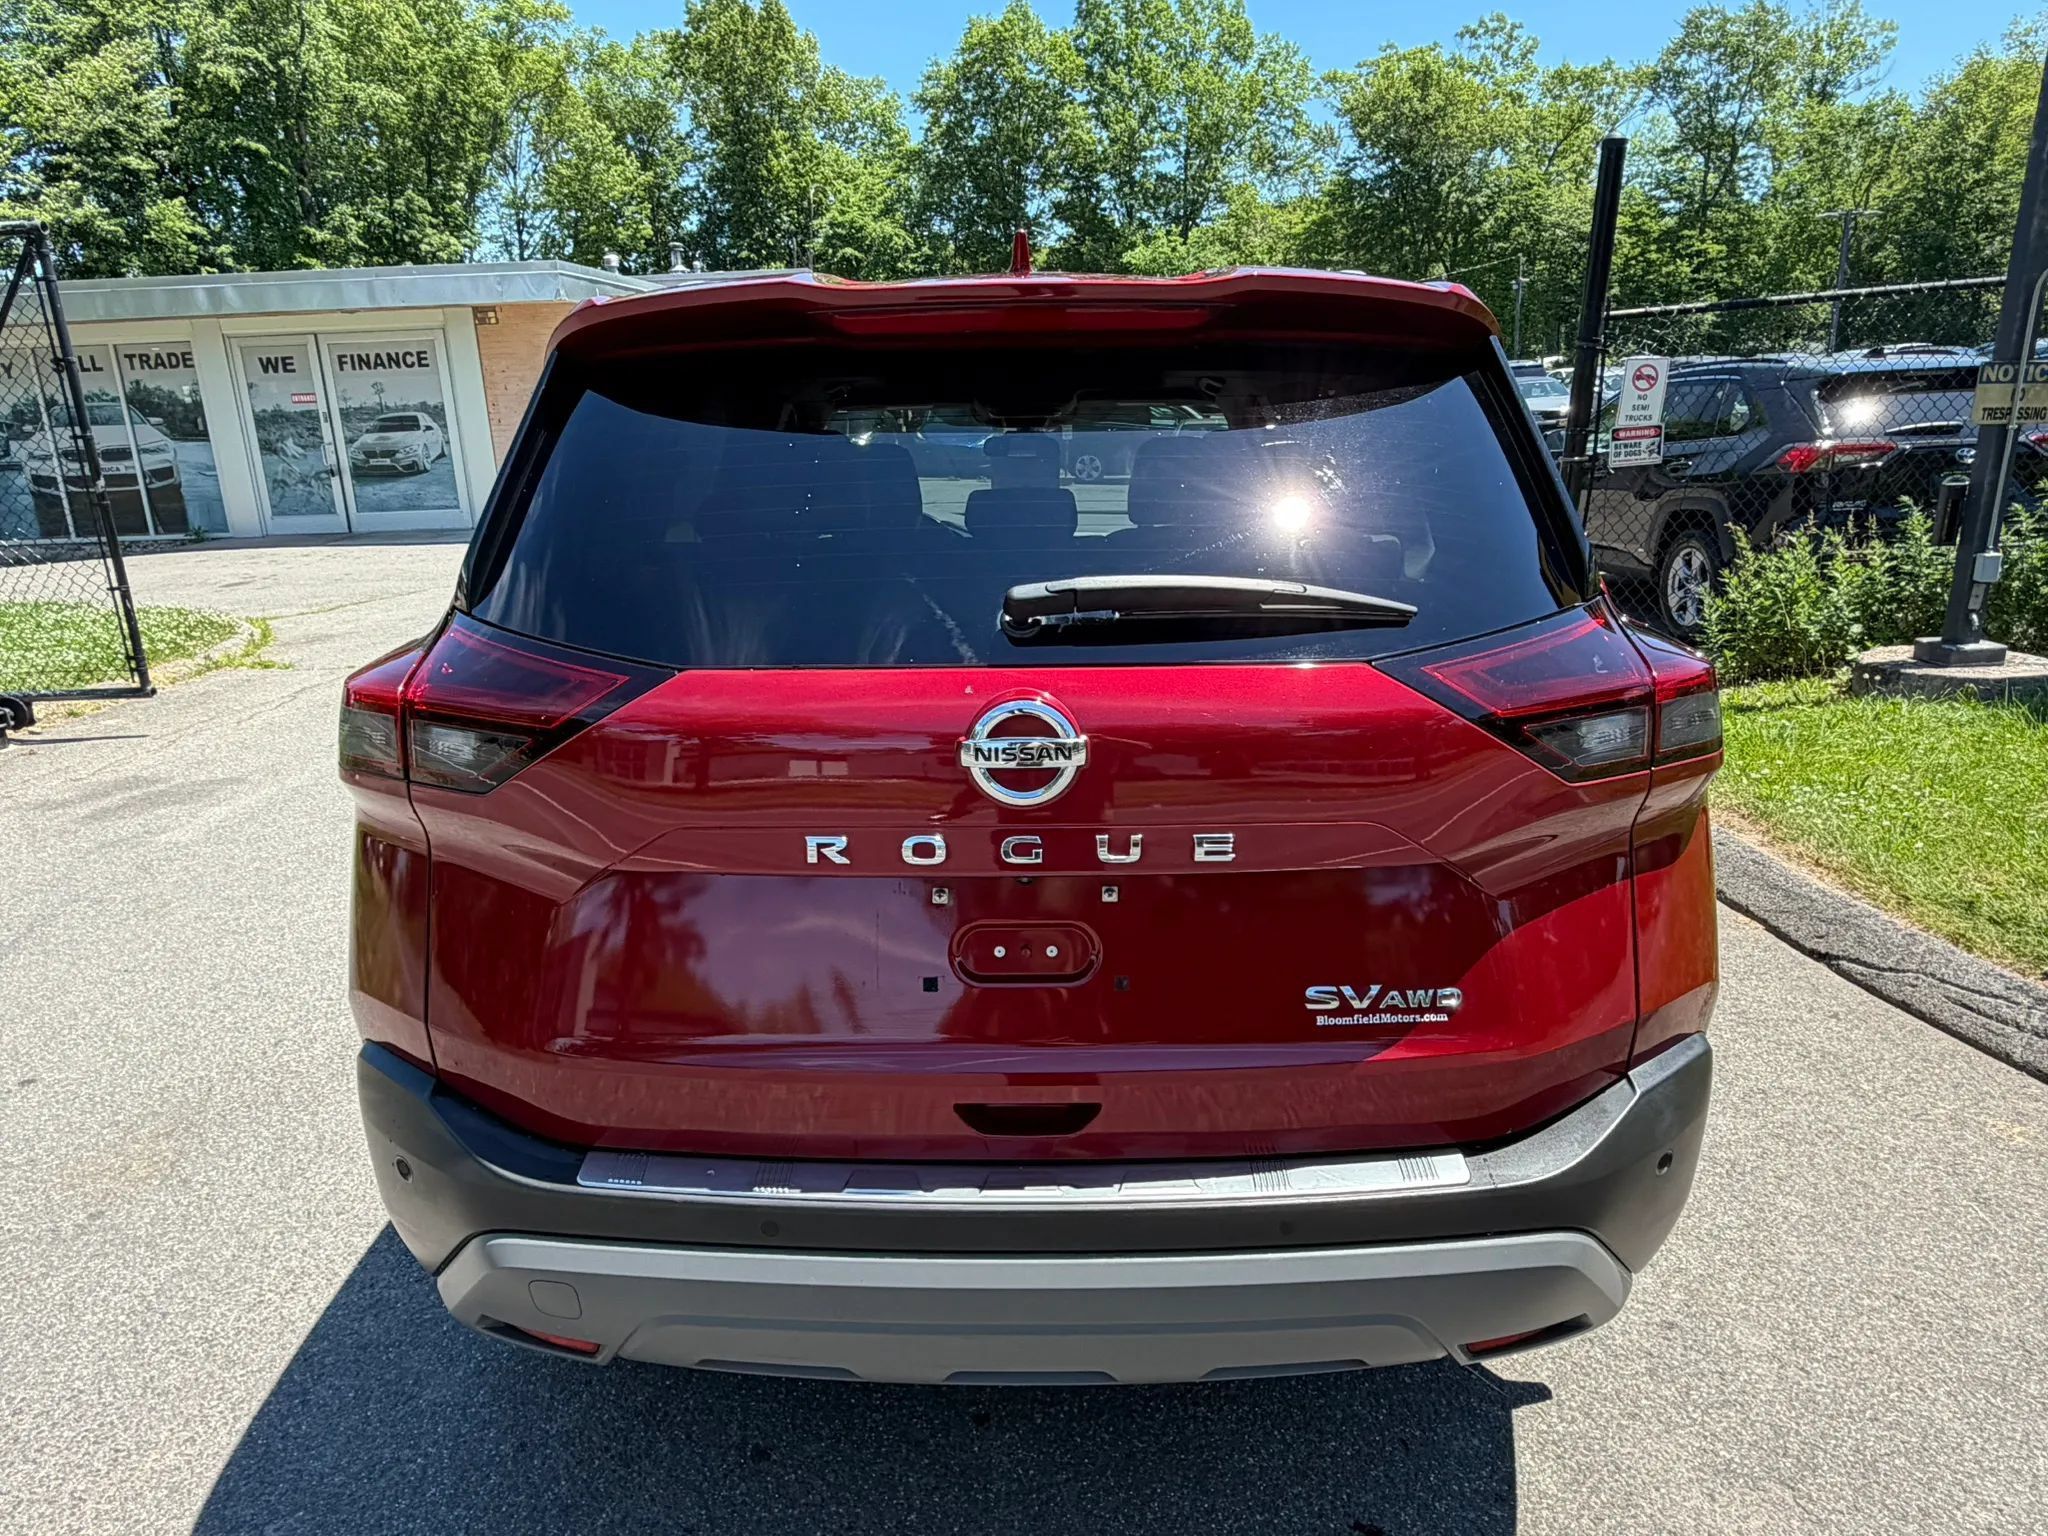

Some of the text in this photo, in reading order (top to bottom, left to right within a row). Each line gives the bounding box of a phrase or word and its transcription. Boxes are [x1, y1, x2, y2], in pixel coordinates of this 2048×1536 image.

[51, 354, 104, 374] SLL
[124, 351, 195, 370] TRADE
[258, 350, 430, 374] WE FINANCE
[1981, 363, 2048, 382] NOIC
[1624, 414, 1653, 422] TRUCKS
[1981, 406, 2048, 420] TRESPSSING
[1618, 428, 1656, 438] WARNING
[1613, 442, 1642, 450] BEWARE
[974, 745, 1073, 763] NISSAN
[804, 833, 1237, 866] ROGUE
[1304, 984, 1463, 1010] SV AWD
[1316, 1013, 1449, 1026] BloomfieldMotors.com
